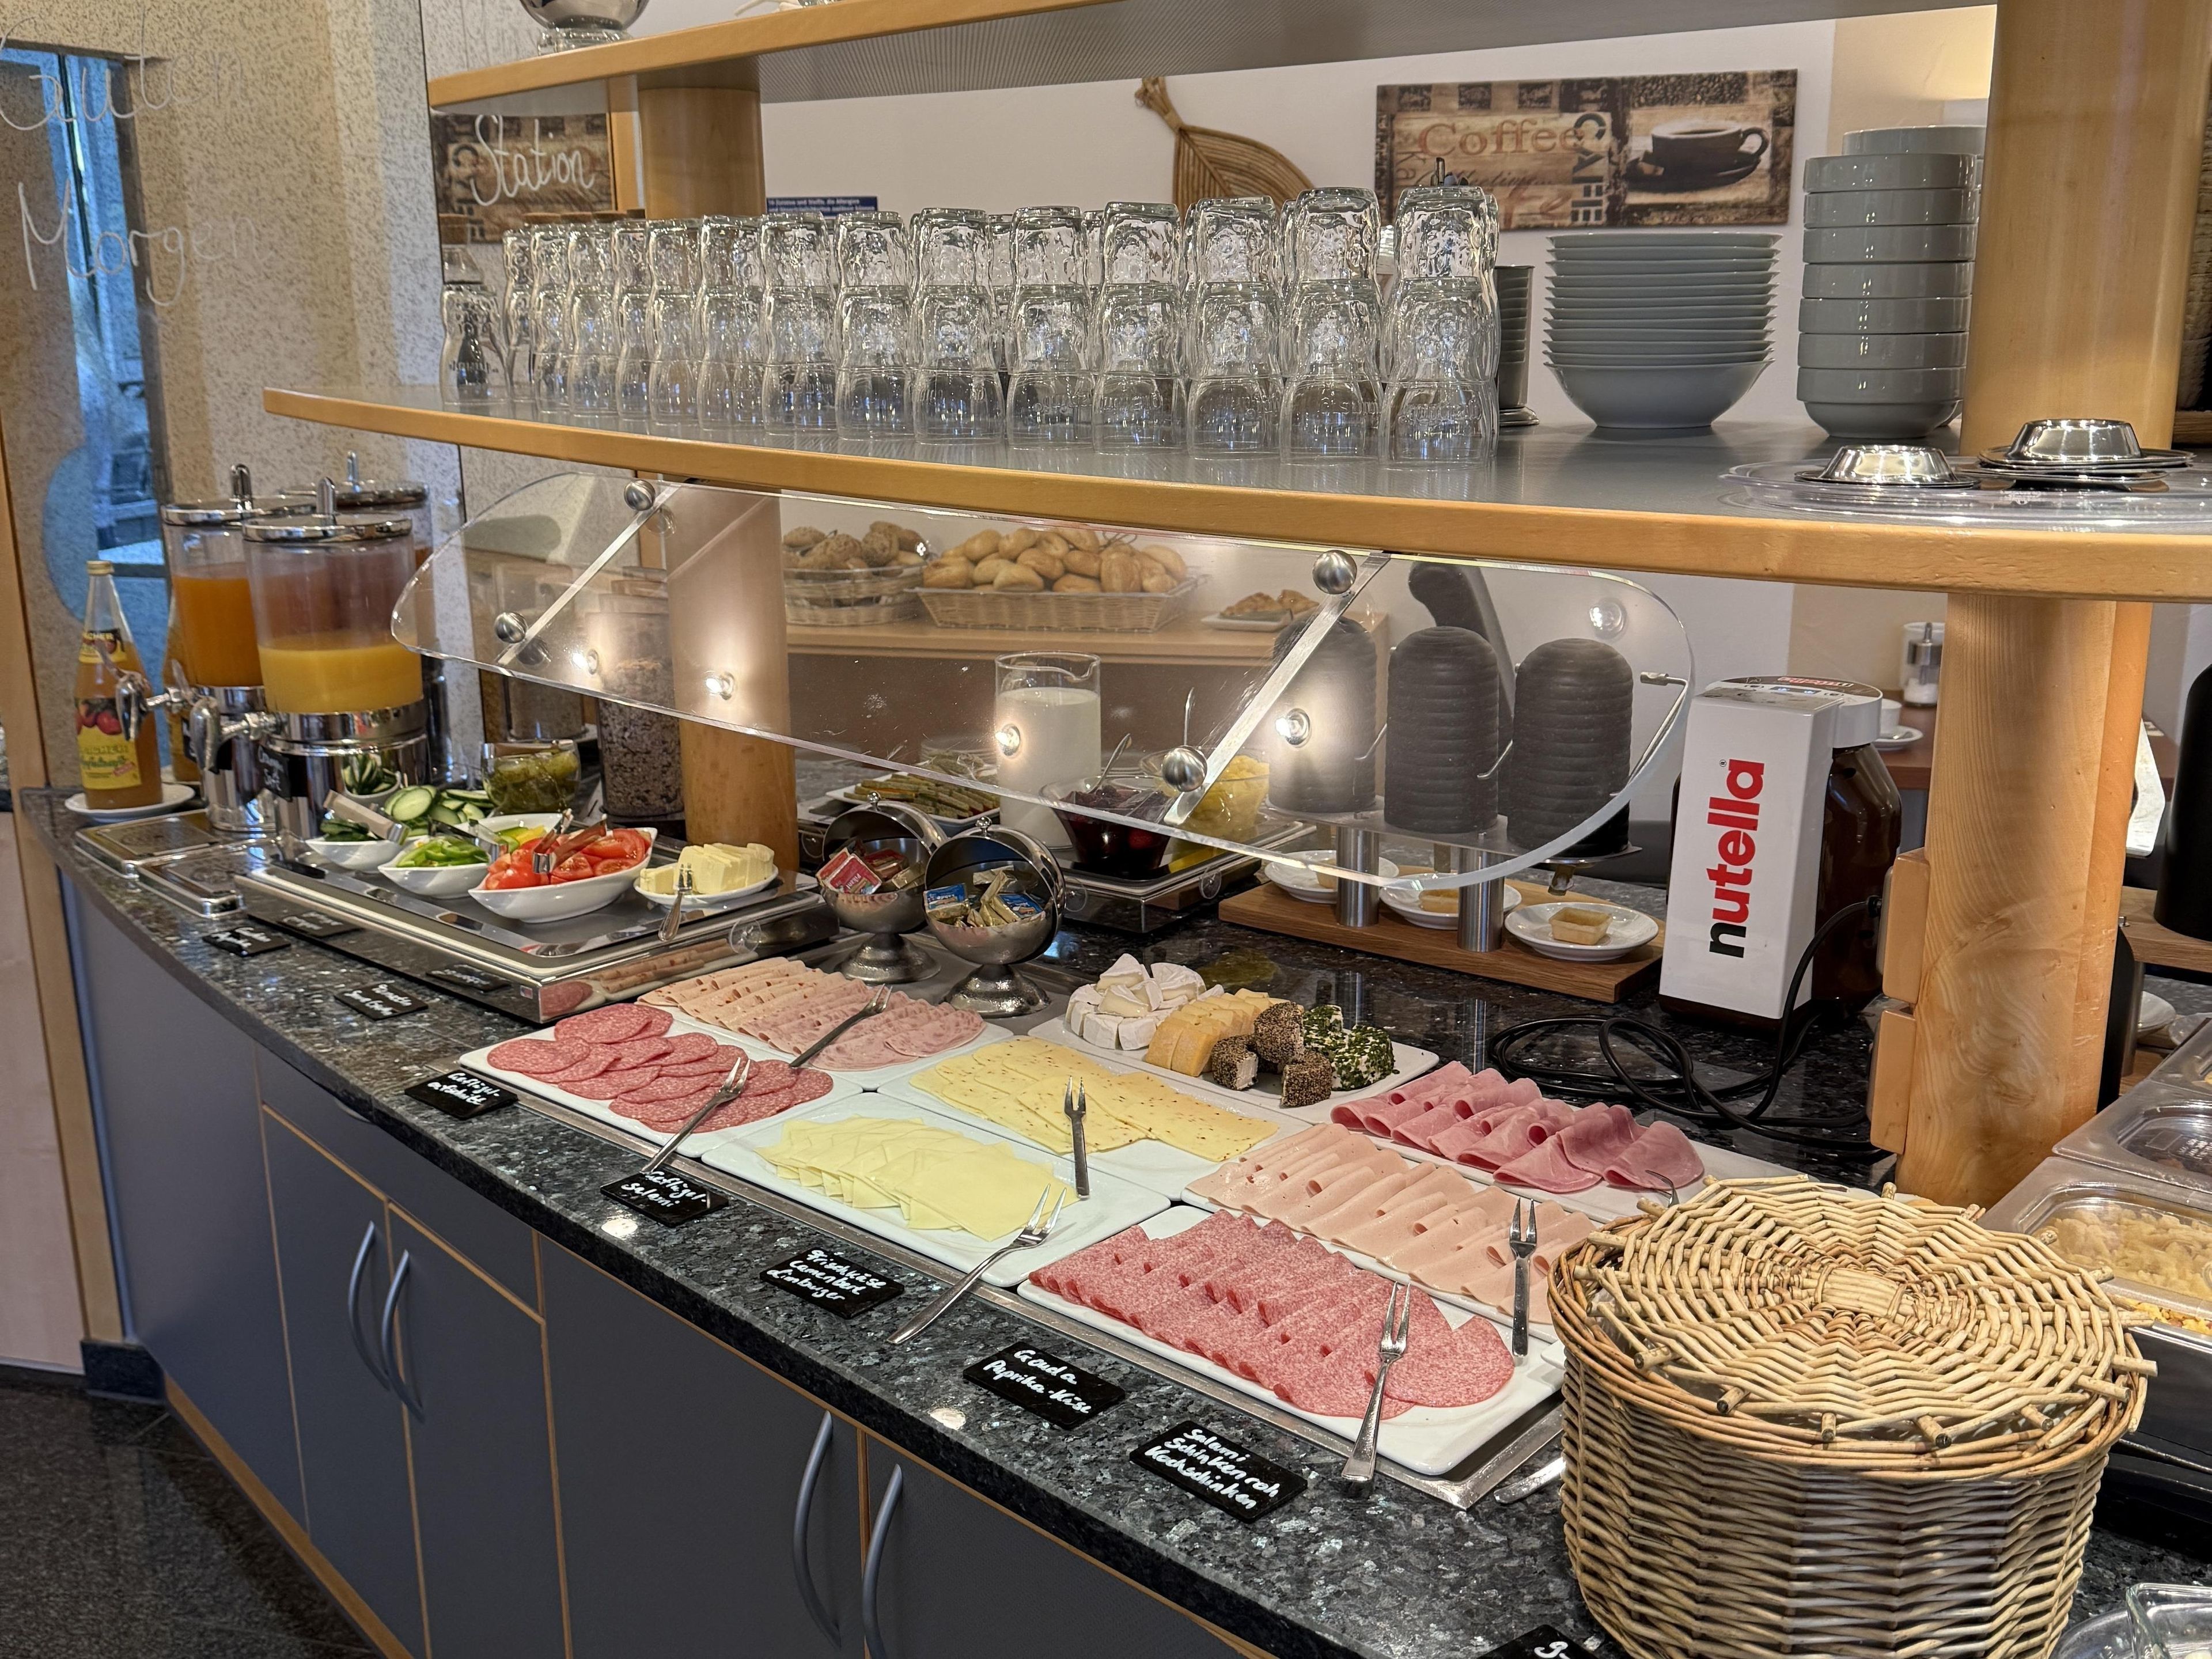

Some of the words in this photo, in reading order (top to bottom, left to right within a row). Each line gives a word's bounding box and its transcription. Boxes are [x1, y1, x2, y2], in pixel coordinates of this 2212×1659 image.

[0, 5, 244, 131] Guten
[468, 114, 596, 206] Station
[1417, 117, 1586, 157] Coffee
[18, 178, 275, 306] Morgen
[1706, 759, 1765, 959] nutella
[620, 1182, 681, 1207] Salami
[766, 1268, 846, 1300] Limburger
[1013, 1349, 1077, 1385] Gouda
[1164, 1437, 1248, 1480] Schinken
[1244, 1476, 1281, 1498] roh
[1183, 1429, 1251, 1463] Salami
[1144, 1445, 1257, 1510] Kochschinken
